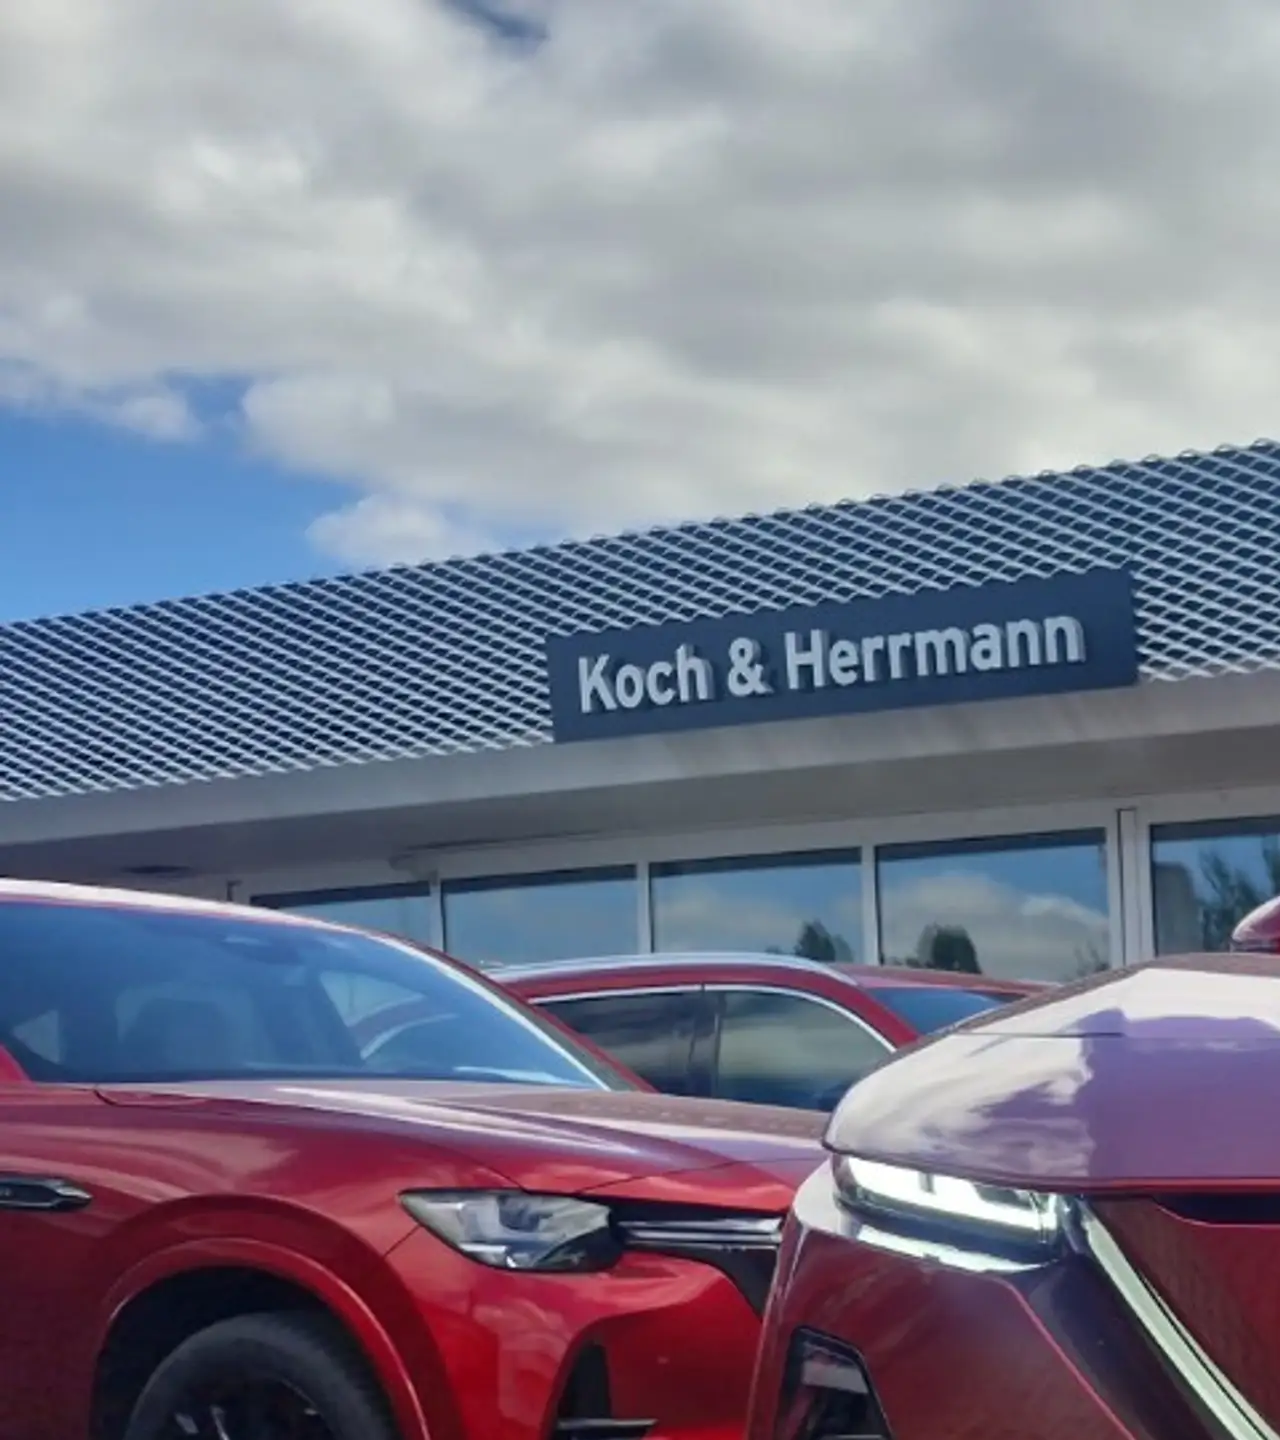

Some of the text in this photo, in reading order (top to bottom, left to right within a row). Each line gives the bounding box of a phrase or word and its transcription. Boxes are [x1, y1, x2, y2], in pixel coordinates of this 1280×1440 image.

[579, 615, 1087, 713] Koch & Herrmann
